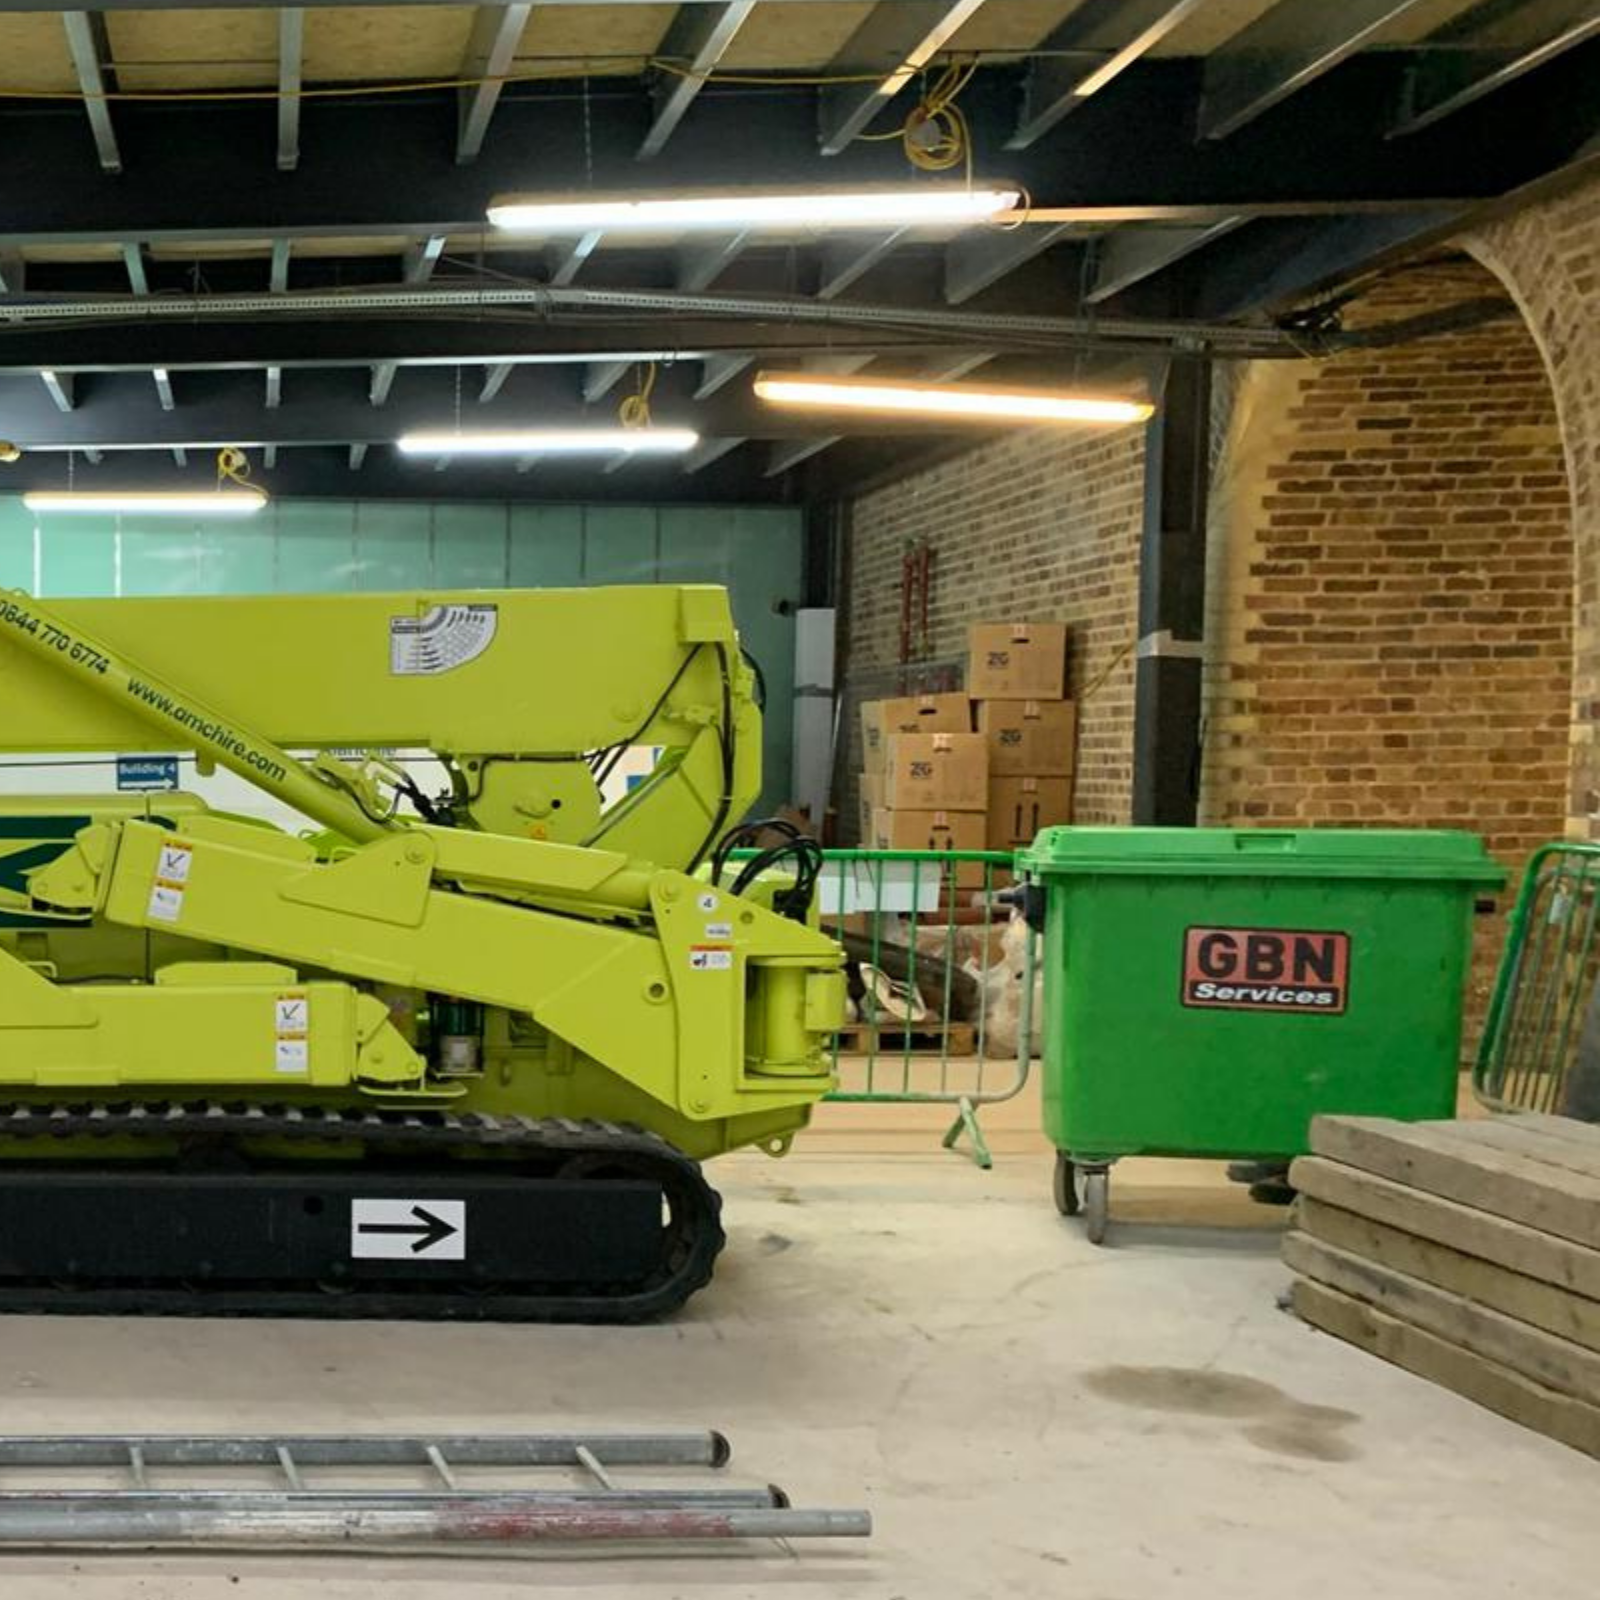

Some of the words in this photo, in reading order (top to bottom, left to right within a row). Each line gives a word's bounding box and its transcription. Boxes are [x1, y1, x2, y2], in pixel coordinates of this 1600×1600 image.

[39, 623, 71, 651] 770
[69, 642, 110, 674] 6774
[126, 677, 287, 782] www.amchire.com
[119, 763, 165, 776] Building
[1197, 933, 1335, 983] GBN
[1194, 983, 1334, 1005] Services
